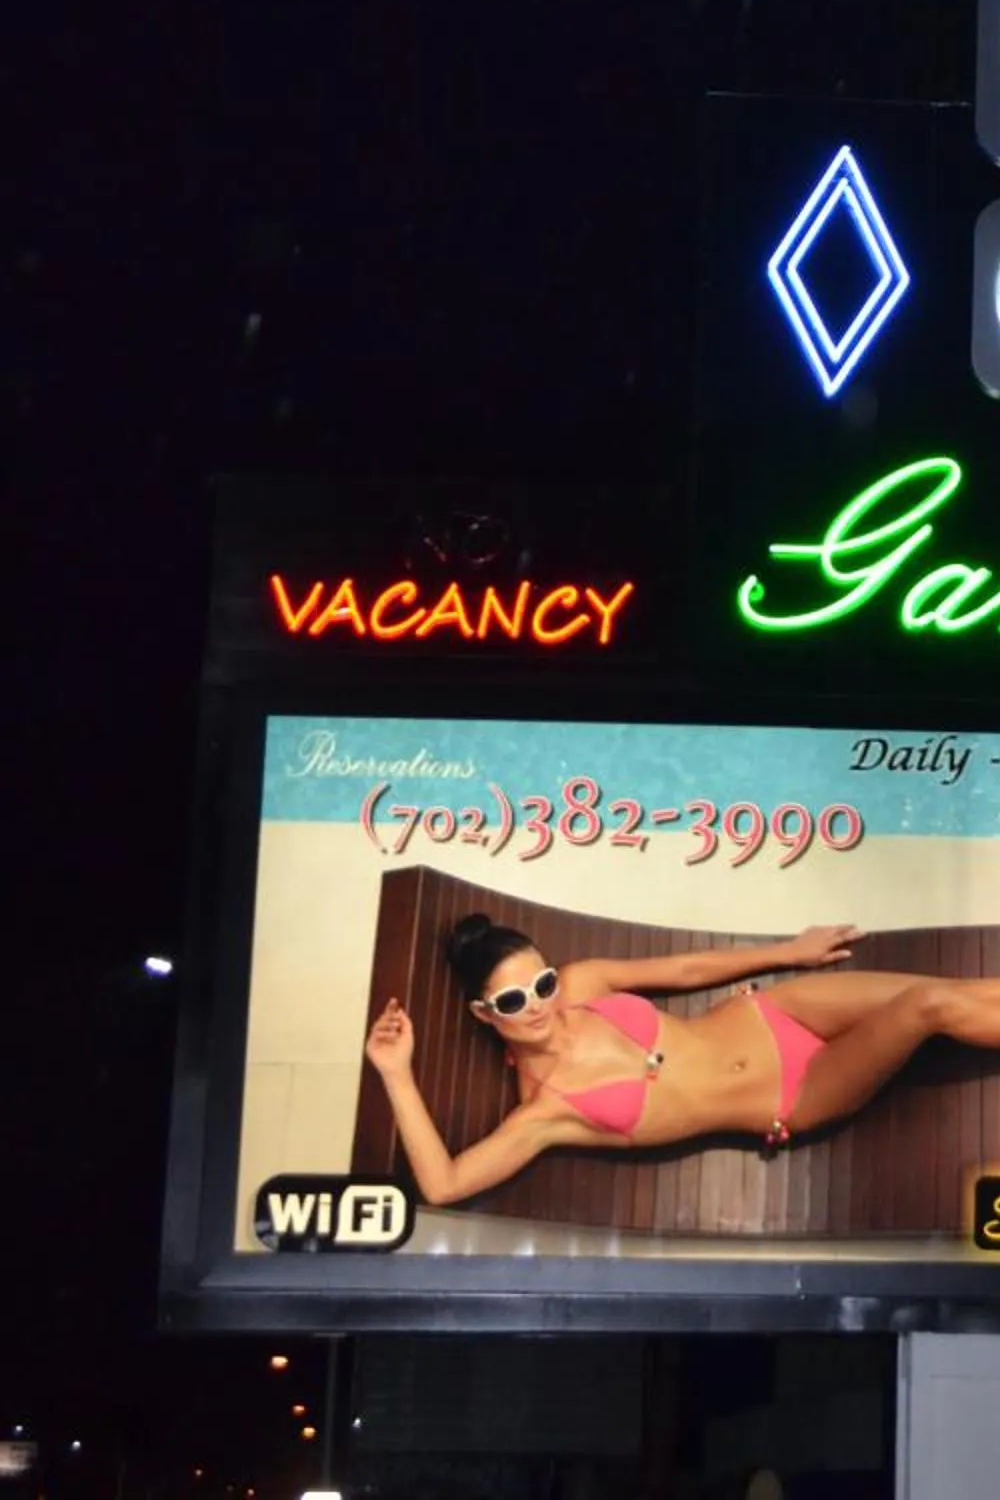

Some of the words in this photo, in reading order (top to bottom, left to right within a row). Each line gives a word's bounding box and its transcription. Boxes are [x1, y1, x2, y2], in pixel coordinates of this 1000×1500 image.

[269, 573, 633, 646] VACANCY
[284, 729, 477, 780] Reservations
[850, 737, 972, 785] Daily
[360, 775, 863, 869] (702)382-3990
